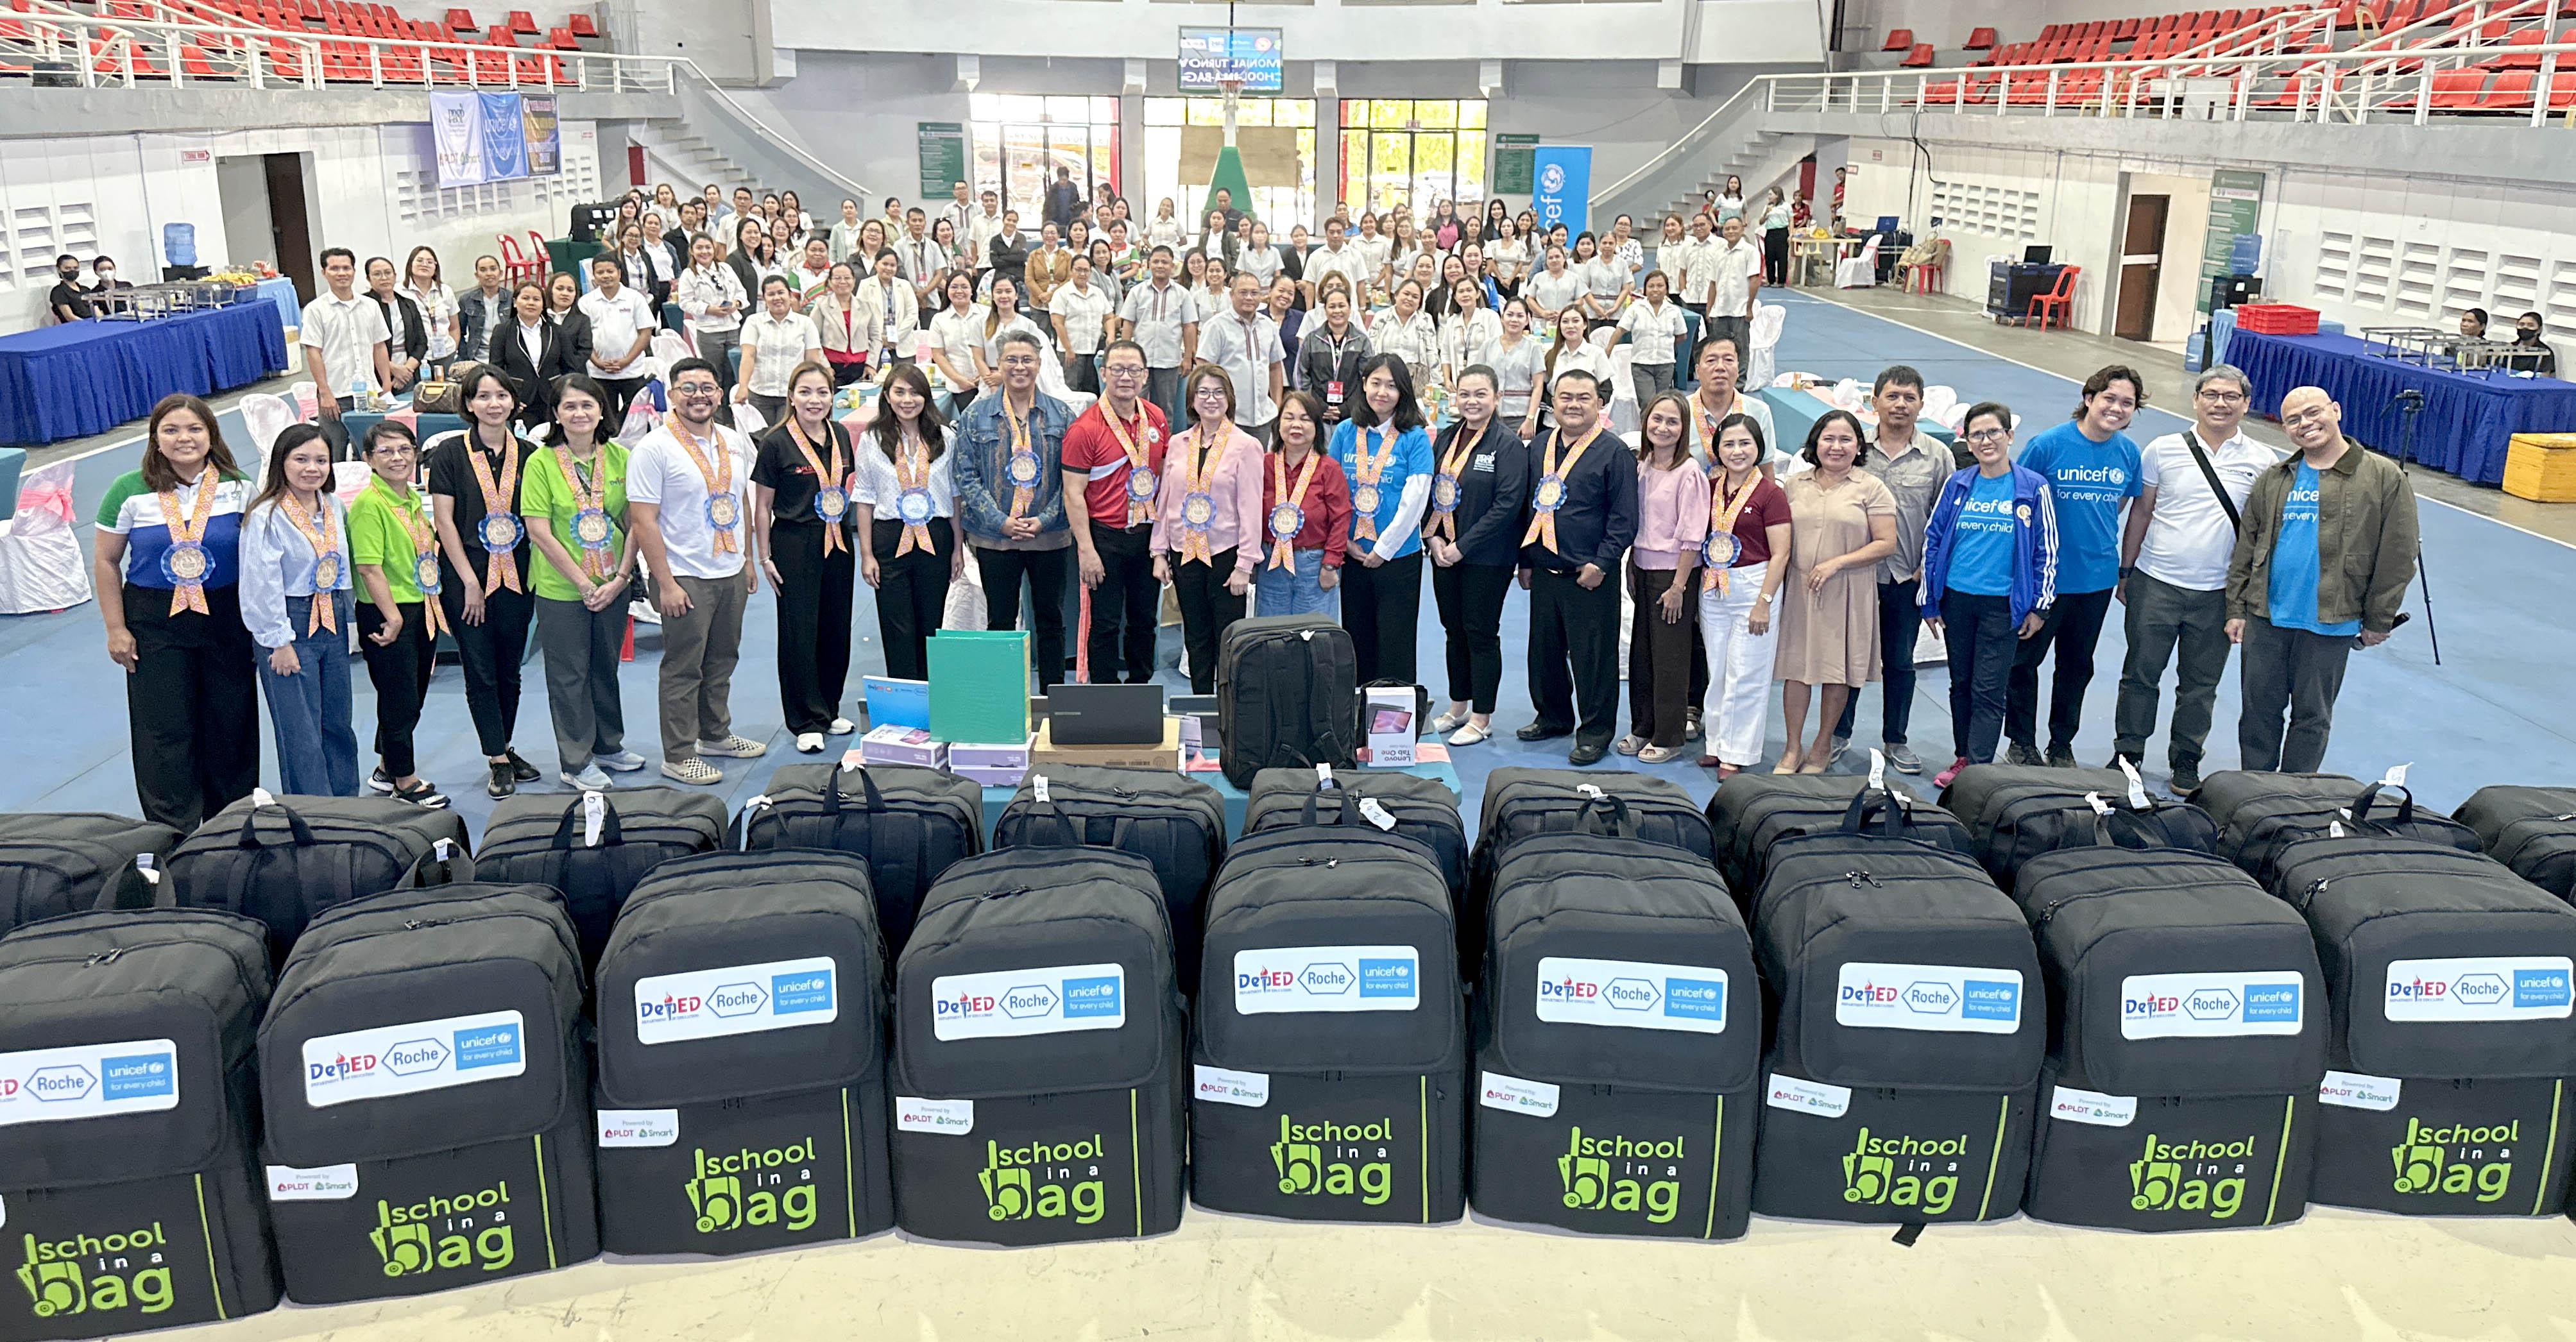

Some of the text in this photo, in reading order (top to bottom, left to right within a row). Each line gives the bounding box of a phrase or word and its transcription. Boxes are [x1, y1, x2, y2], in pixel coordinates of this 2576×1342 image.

[1540, 195, 1562, 232] cef
[1379, 473, 1393, 484] hild
[2057, 465, 2109, 482] unicef
[2057, 488, 2071, 499] for
[2072, 491, 2102, 504] every
[2287, 486, 2319, 502] nice
[1965, 497, 1998, 513] nicef
[2289, 513, 2318, 523] every
[1961, 522, 1988, 534] every
[1989, 521, 2013, 533] child
[1308, 972, 1345, 985] Roche
[1365, 966, 1396, 977] unicef
[779, 979, 811, 993] unicef
[1239, 972, 1293, 993] DepED
[2461, 981, 2499, 994] Roche
[2520, 976, 2551, 988] unicef
[1069, 985, 1100, 998] unicef
[1542, 980, 1598, 1003] DepED
[1613, 986, 1650, 1001] Roche
[1671, 987, 1703, 999] unicef
[1842, 986, 1897, 1007] DepED
[1911, 990, 1950, 1004] Roche
[1969, 990, 2000, 1001] unicef
[2249, 991, 2280, 1003] unicef
[2391, 981, 2446, 1001] DepED
[641, 996, 701, 1020] DepED
[717, 992, 758, 1008] Roche
[780, 998, 789, 1006] for
[810, 994, 826, 1004] child
[937, 997, 994, 1018] DepED
[1010, 994, 1048, 1009] Roche
[1098, 1000, 1114, 1008] child
[1671, 1002, 1716, 1012] for every child
[2126, 997, 2179, 1019] DepED
[2193, 997, 2230, 1010] Roche
[1996, 1005, 2011, 1013] child
[2259, 1008, 2276, 1016] every
[461, 1033, 496, 1049] unicef
[394, 1048, 439, 1066] Roche
[463, 1047, 513, 1060] for every child
[109, 1063, 148, 1077] unicef
[311, 1054, 376, 1080] DepED
[37, 1075, 84, 1091] Roche
[124, 1081, 145, 1090] every
[147, 1078, 166, 1088] child
[1209, 1084, 1263, 1099] PLDT Smart
[2330, 1088, 2393, 1102] PLDT Smart
[1495, 1092, 1553, 1109] PLDT Smart
[1783, 1092, 1843, 1111] PLDT Smart
[2067, 1105, 2128, 1119] PLDT Smart
[945, 1117, 968, 1126] Smart
[1291, 1117, 1392, 1141] school
[648, 1129, 673, 1137] Smart
[2418, 1119, 2518, 1143] school
[999, 1134, 1104, 1166] school
[1337, 1146, 1386, 1158] in a
[1581, 1135, 1684, 1159] school
[1867, 1134, 1967, 1155] school
[2155, 1135, 2255, 1160] school
[706, 1137, 815, 1175] school
[2460, 1147, 2510, 1159] in a
[1047, 1164, 1098, 1179] in a
[1270, 1135, 1392, 1205] bag
[1626, 1162, 1676, 1176] in a
[1908, 1159, 1957, 1171] in a
[2196, 1162, 2244, 1175] in a
[2392, 1135, 2511, 1202] bag
[325, 1181, 352, 1190] Smart
[757, 1169, 810, 1187] in a
[1558, 1146, 1680, 1223] bag
[1843, 1145, 1959, 1214] bag
[2129, 1153, 2246, 1218] bag
[978, 1160, 1105, 1224] bag
[393, 1180, 510, 1223] school
[685, 1168, 817, 1233] bag
[448, 1210, 505, 1231] in a
[38, 1221, 166, 1260] school
[370, 1216, 514, 1277] bag
[100, 1251, 162, 1270] in a
[17, 1253, 174, 1317] bag
